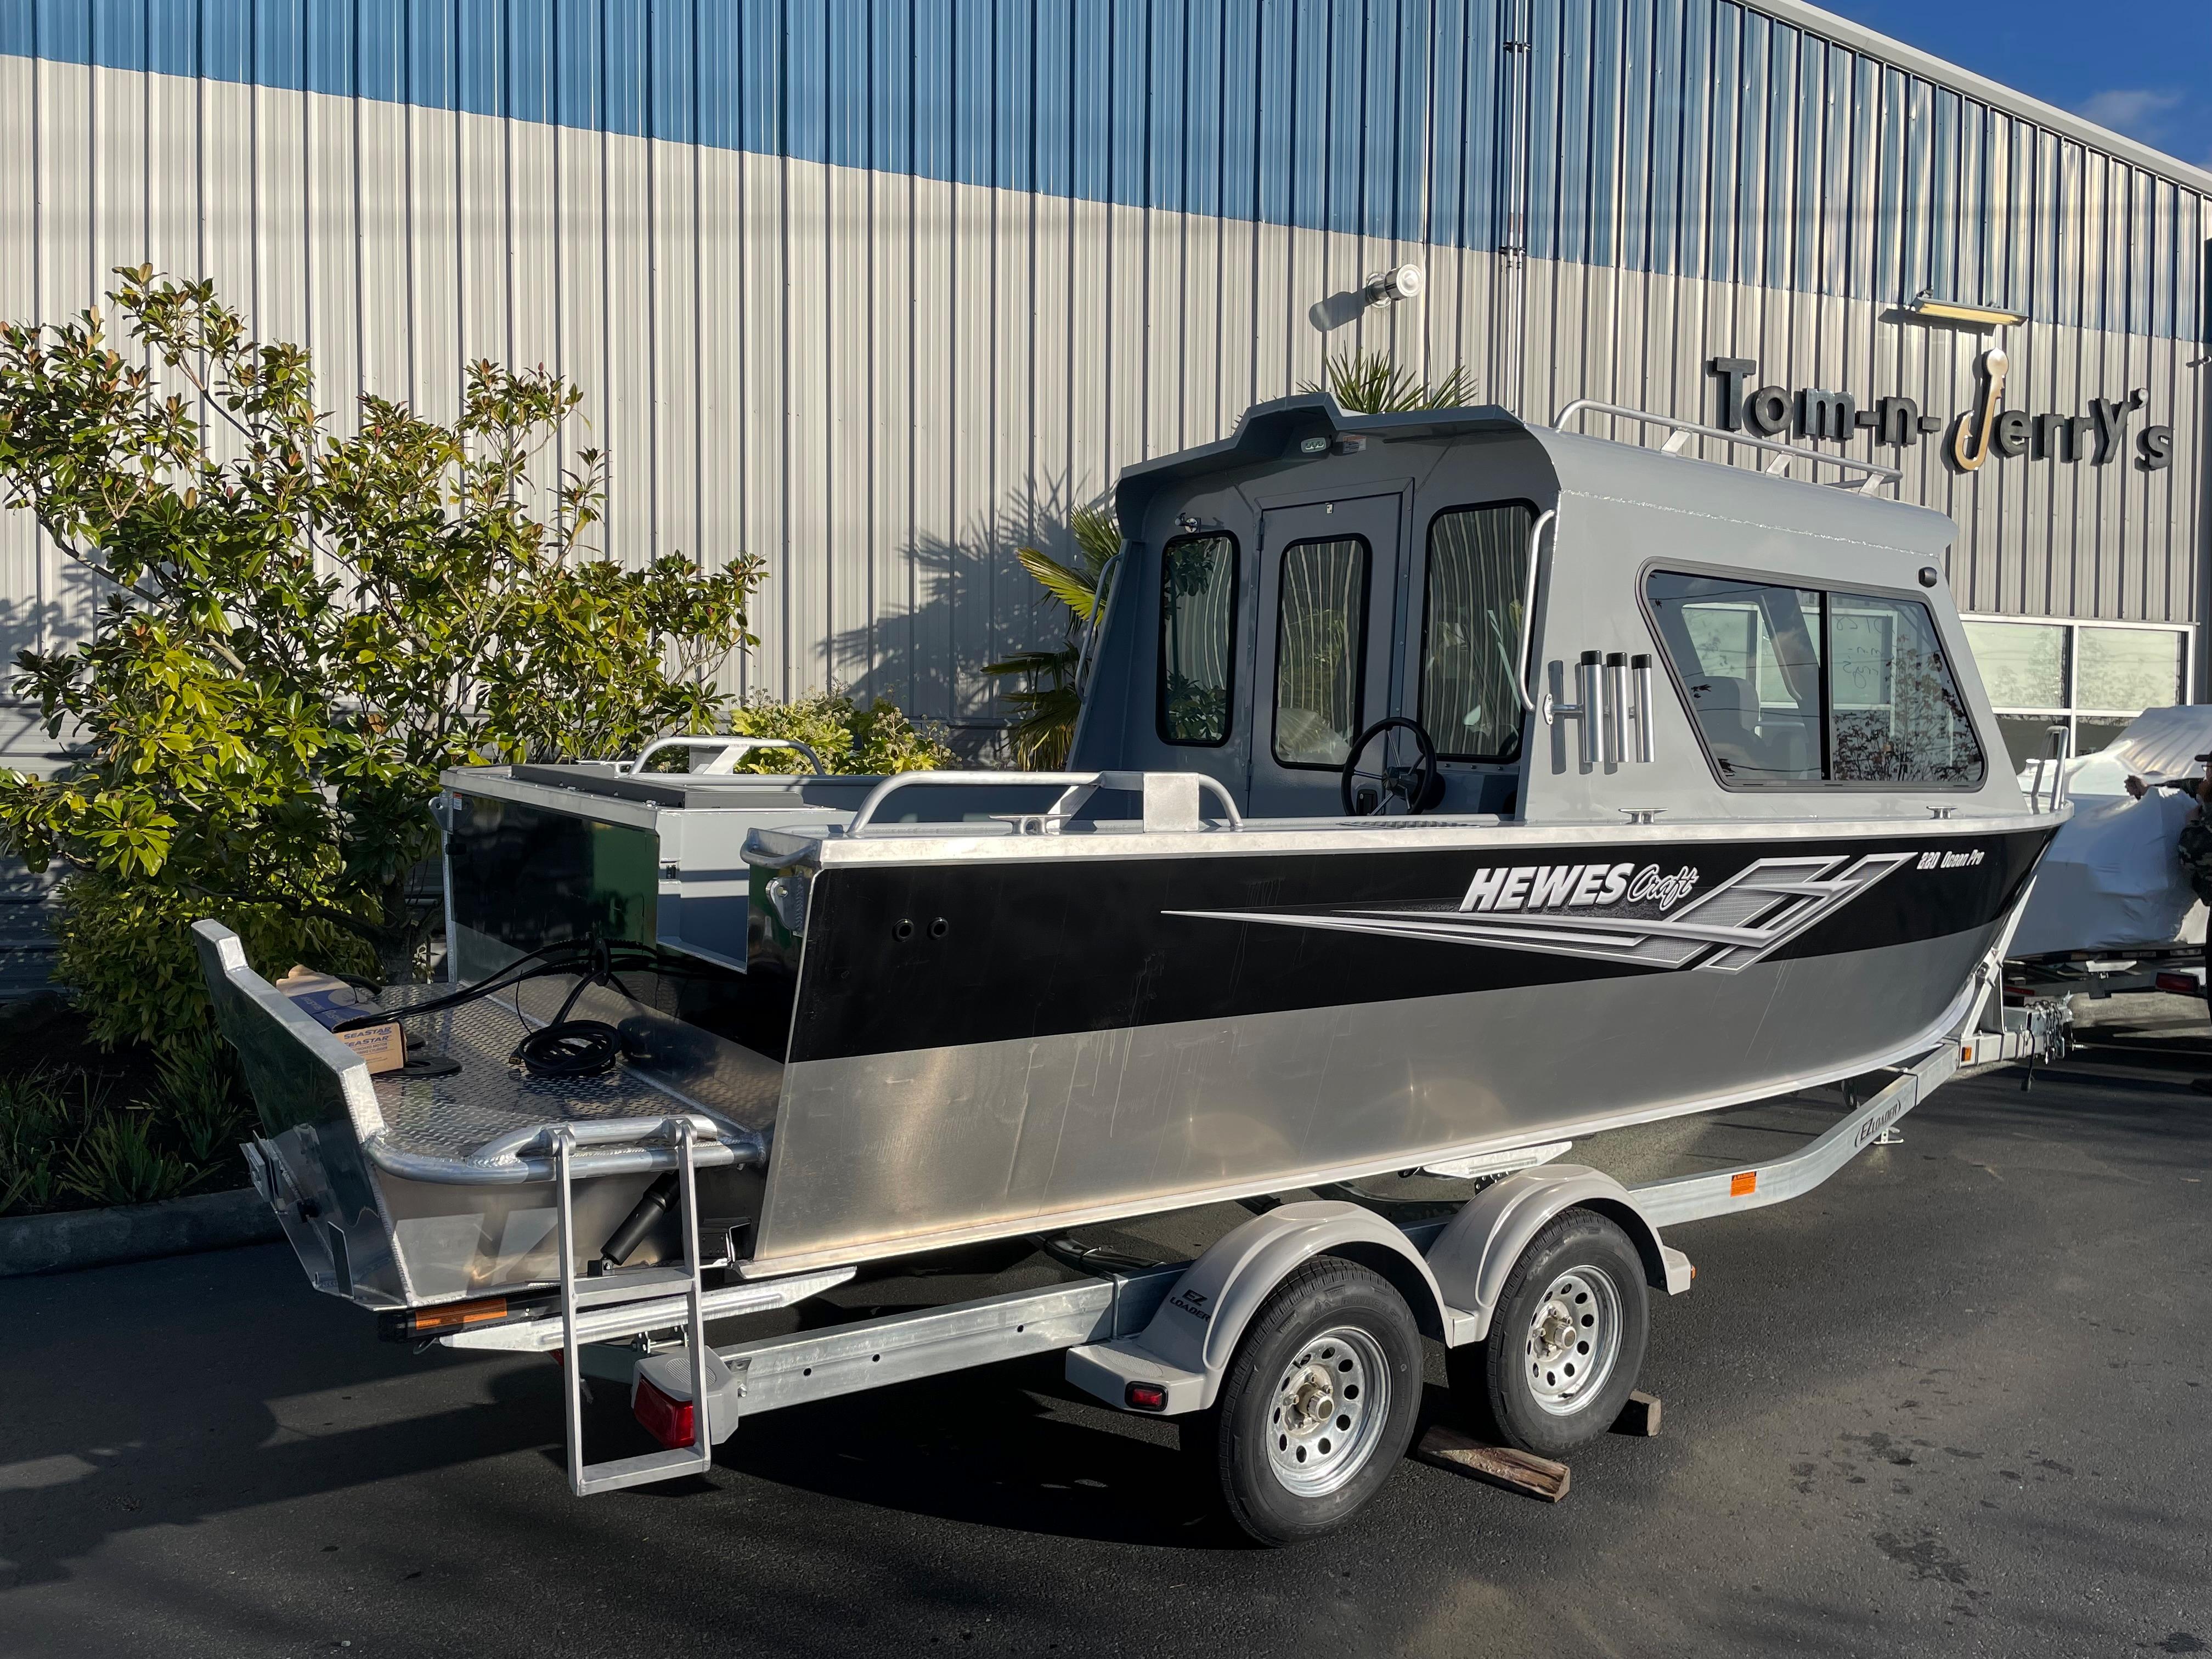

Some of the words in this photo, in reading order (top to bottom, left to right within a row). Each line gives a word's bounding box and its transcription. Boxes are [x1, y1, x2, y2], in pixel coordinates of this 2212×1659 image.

[1916, 851, 1941, 870] 220
[1940, 850, 1970, 868] Ocean
[1966, 849, 1985, 866] Pro
[1458, 863, 1635, 912] HEWES
[1627, 863, 1700, 911] Craft
[1170, 1296, 1211, 1323] LOADER
[1182, 1289, 1208, 1307] EZ
